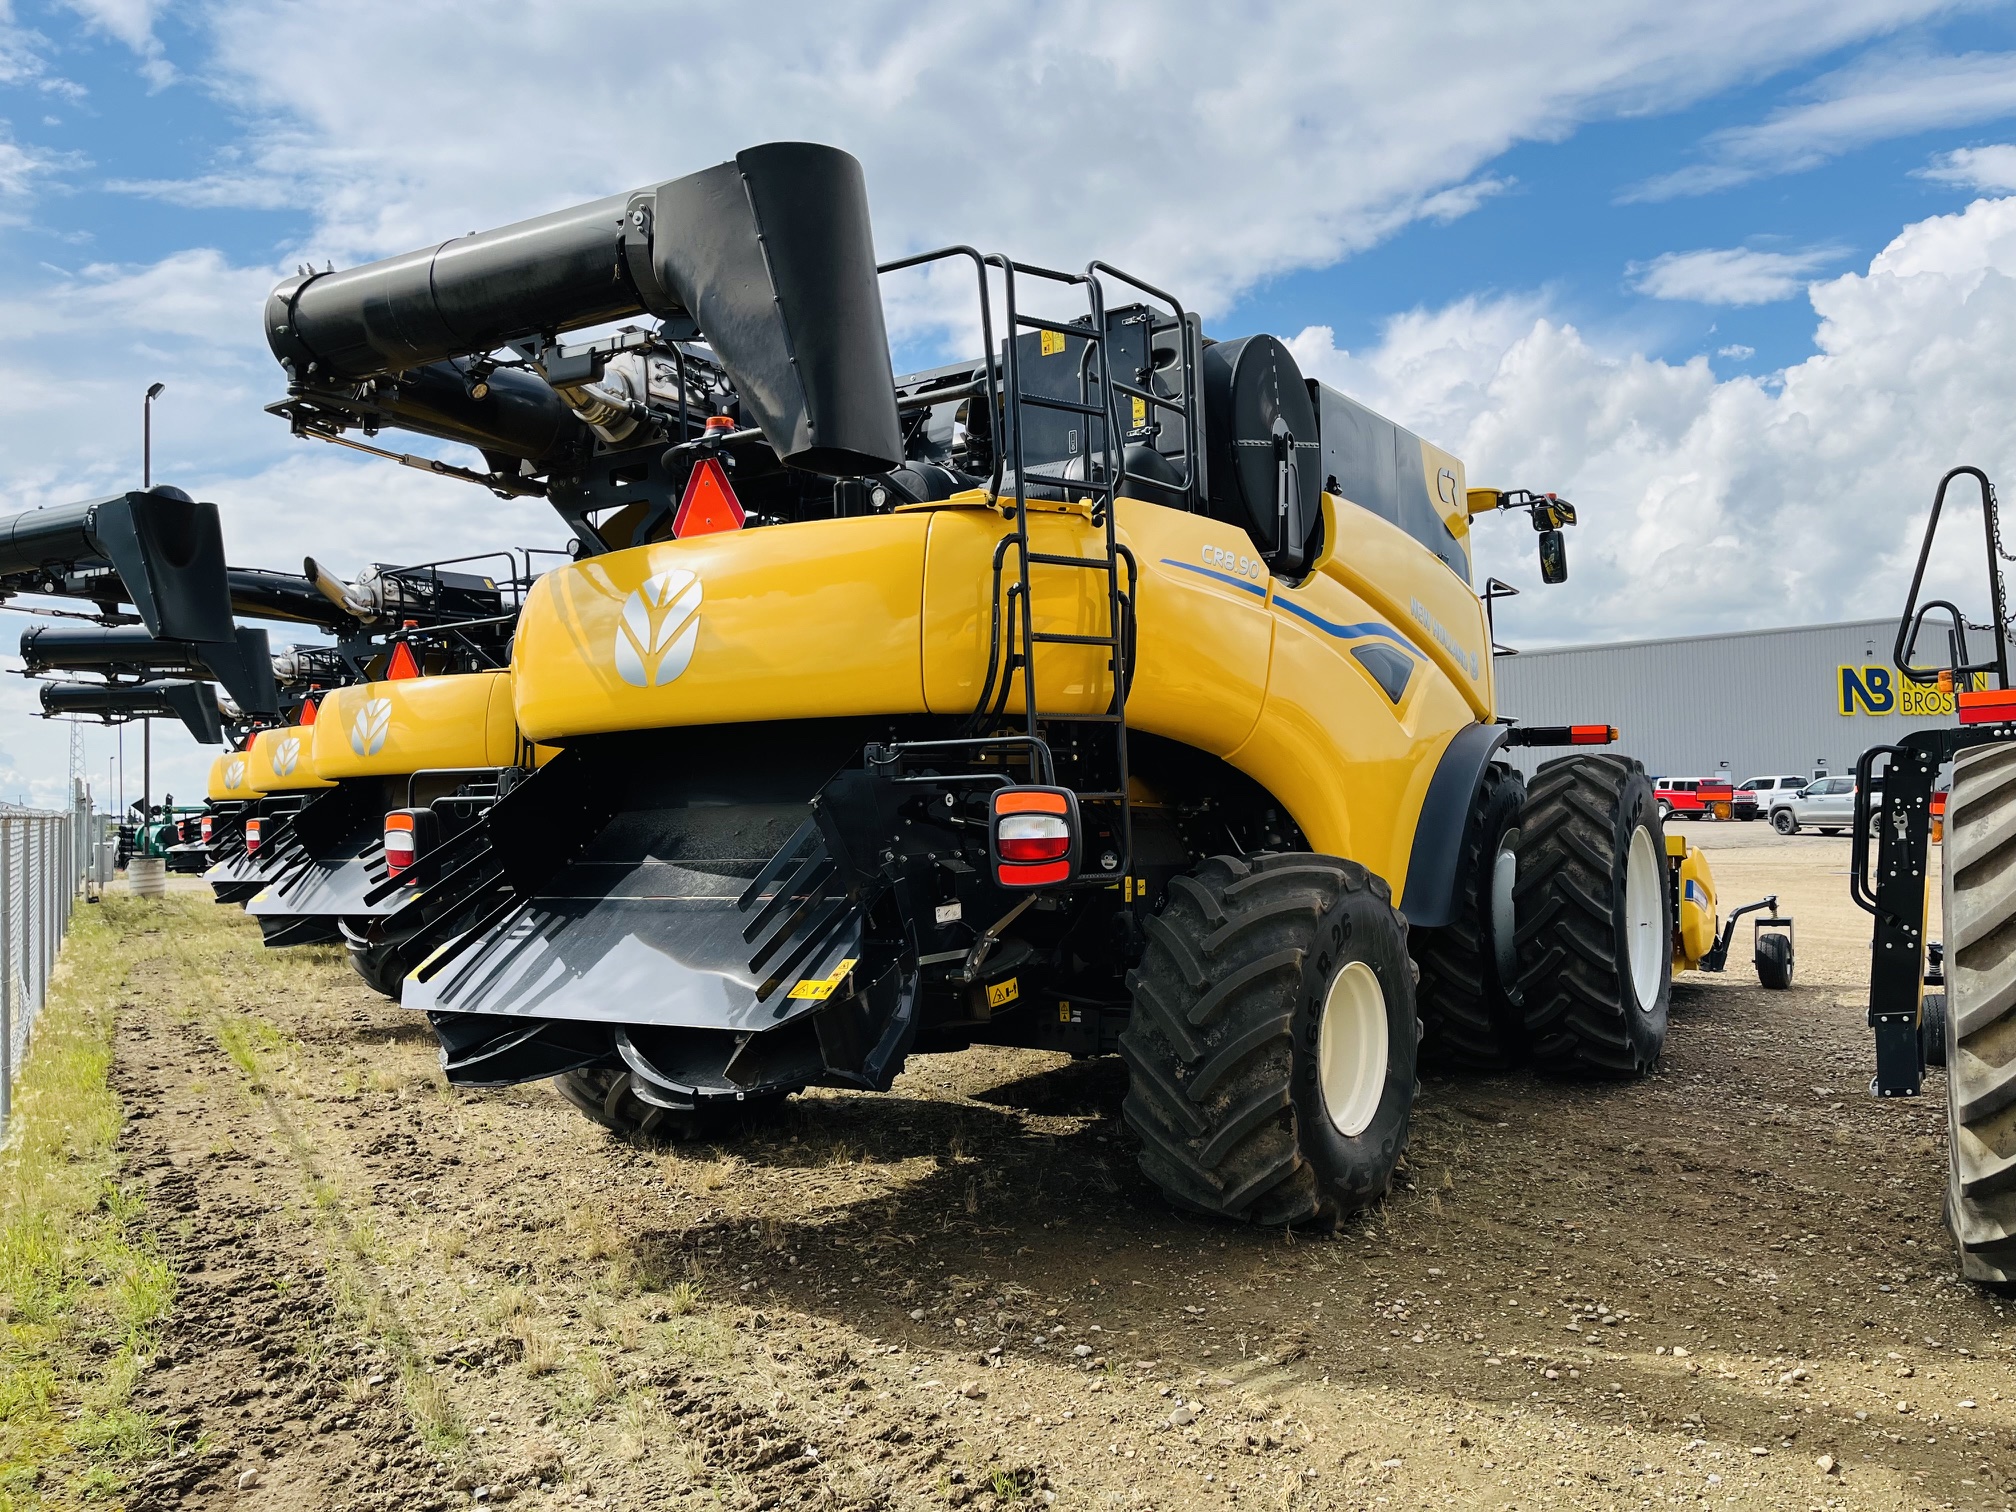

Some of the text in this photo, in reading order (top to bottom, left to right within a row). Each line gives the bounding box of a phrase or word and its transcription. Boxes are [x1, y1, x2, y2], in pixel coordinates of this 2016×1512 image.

[1202, 545, 1259, 579] CR8.90
[1410, 595, 1431, 631] NEW
[1841, 668, 1894, 713] NB
[1903, 691, 1952, 712] BROS
[1332, 913, 1352, 956] 26
